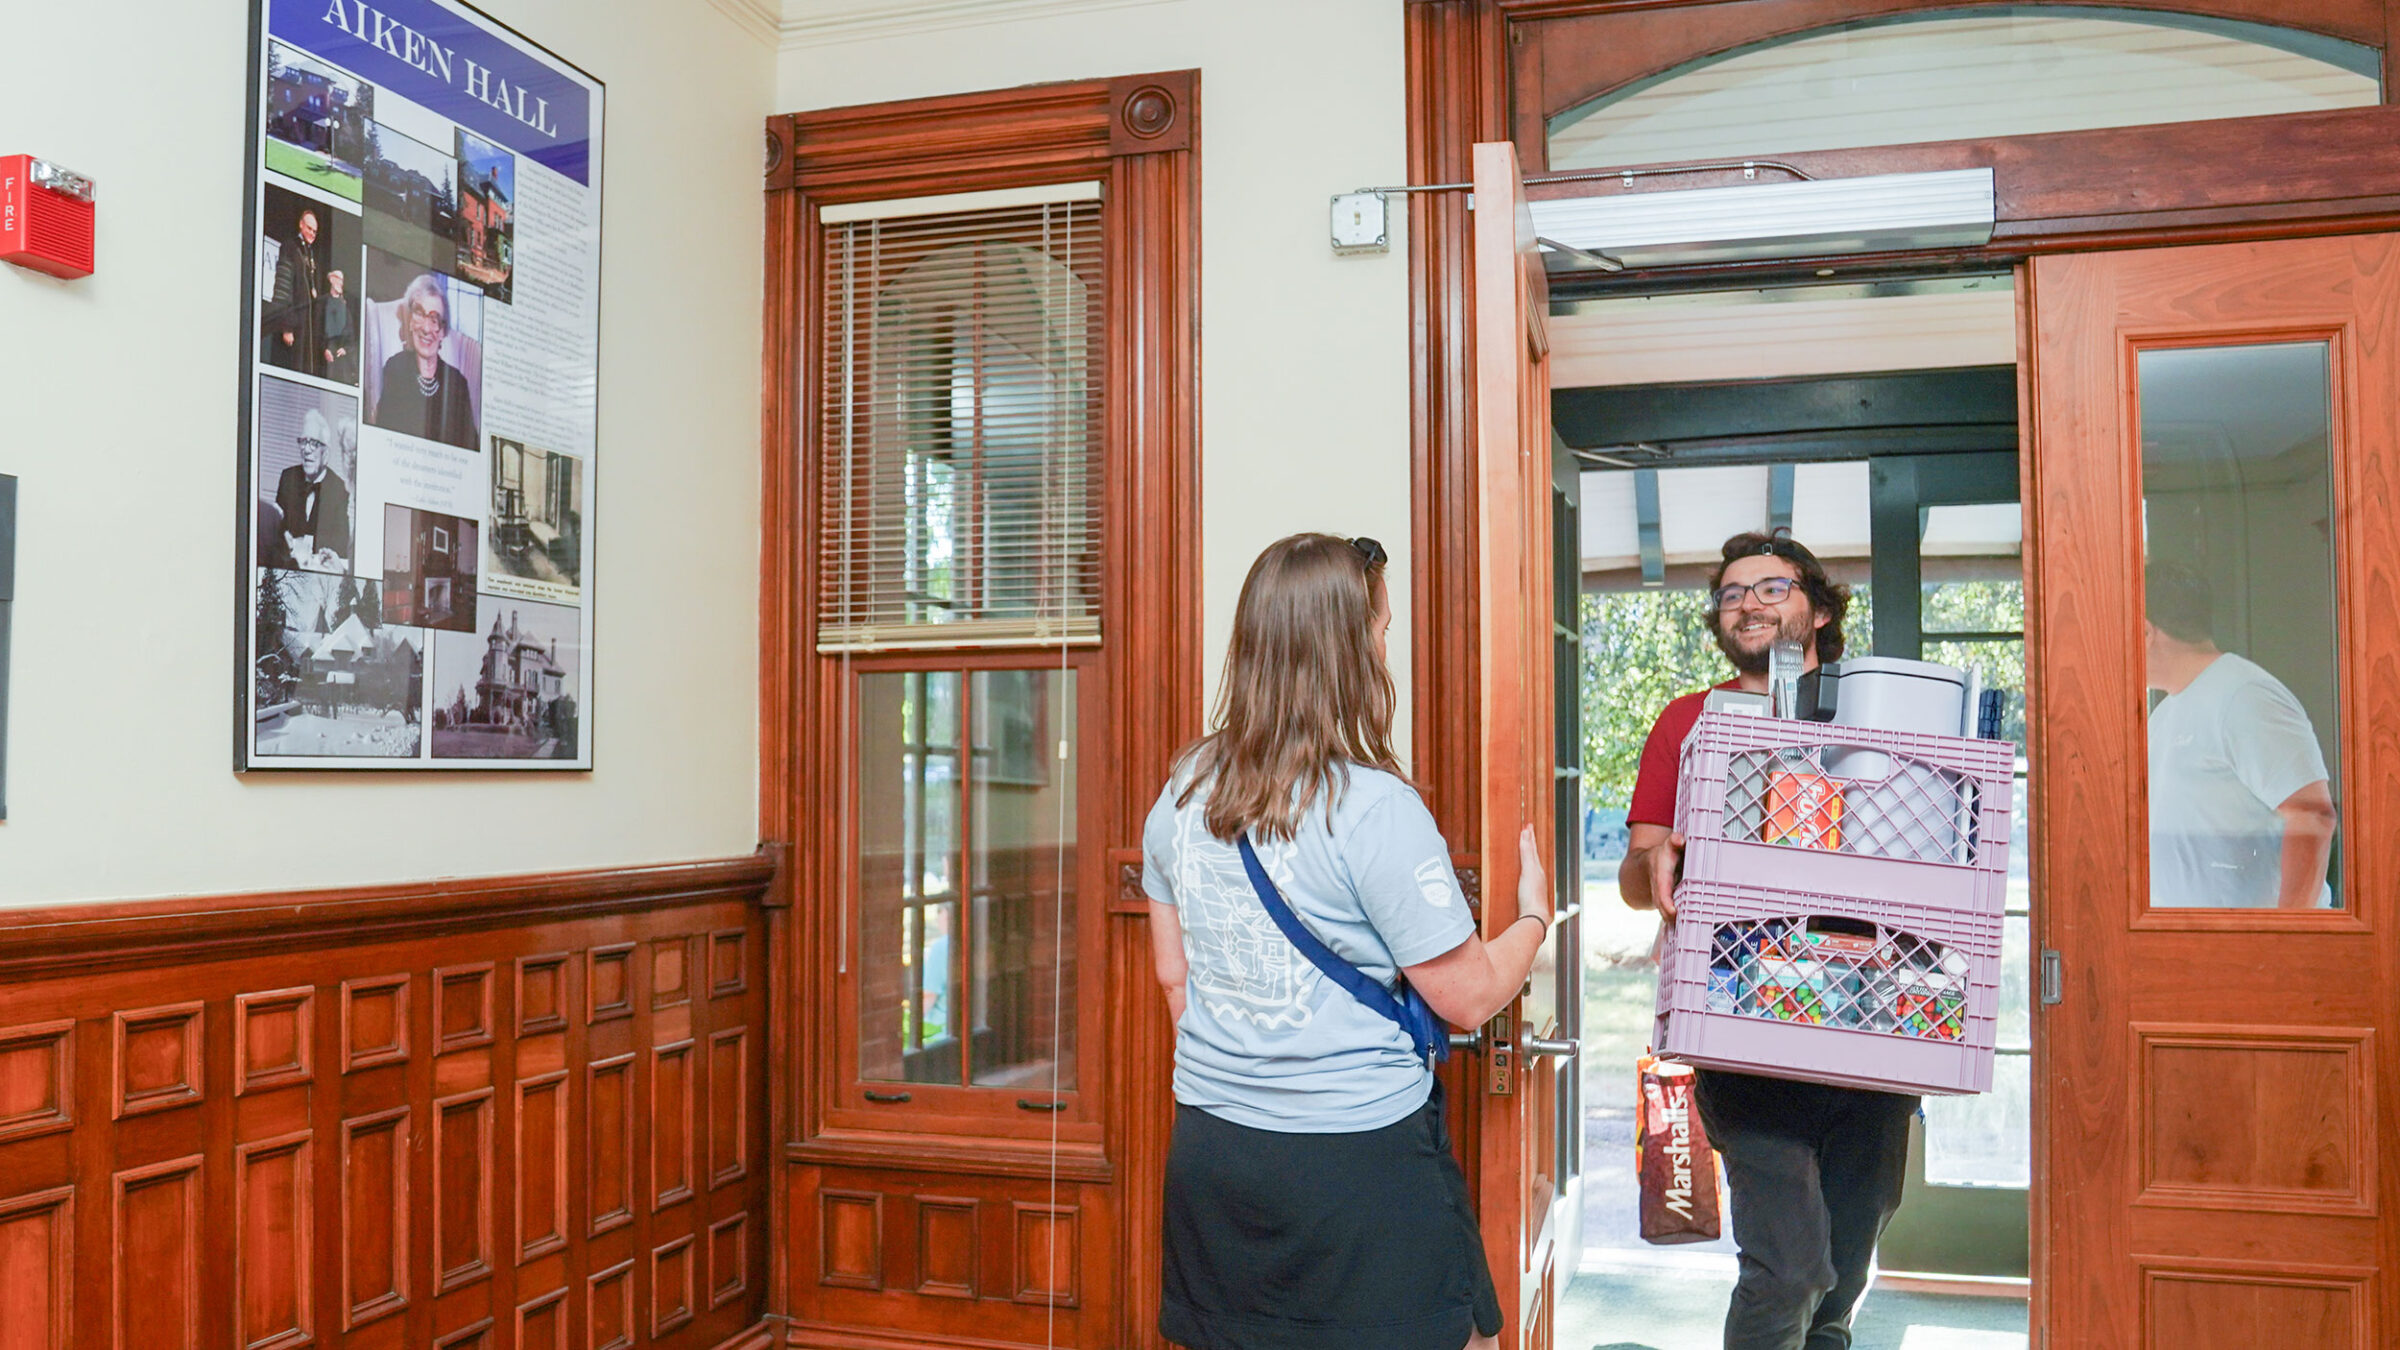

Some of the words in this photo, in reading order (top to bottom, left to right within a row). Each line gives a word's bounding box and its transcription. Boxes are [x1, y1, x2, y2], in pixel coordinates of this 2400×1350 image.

[321, 0, 455, 84] AIKEN
[463, 58, 557, 138] HALL
[5, 177, 16, 231] FIRE
[1660, 1095, 1693, 1221] Marshalls
